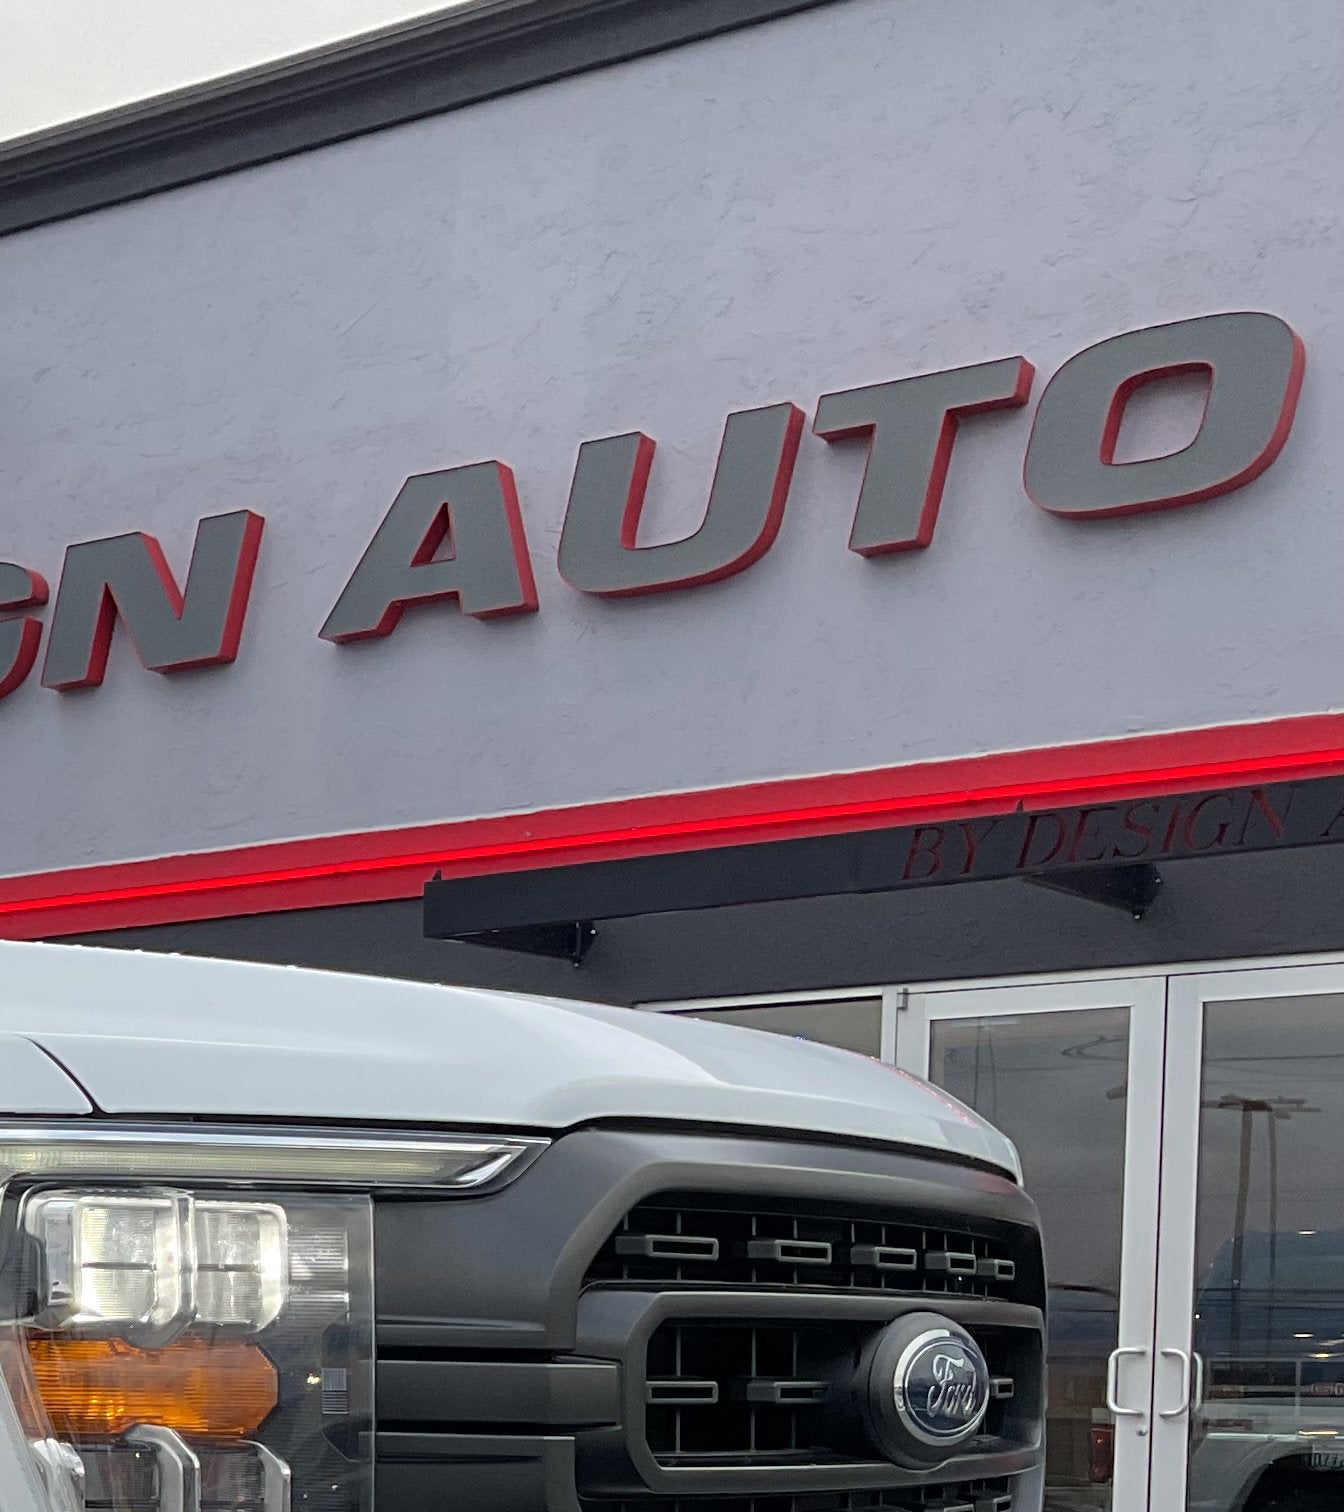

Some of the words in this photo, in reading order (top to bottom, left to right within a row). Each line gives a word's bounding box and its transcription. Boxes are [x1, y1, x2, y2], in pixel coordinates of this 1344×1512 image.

[319, 310, 1306, 644] AUTO
[900, 820, 1002, 881] BY
[1014, 784, 1304, 870] DESIGN
[927, 1354, 976, 1419] Ford
